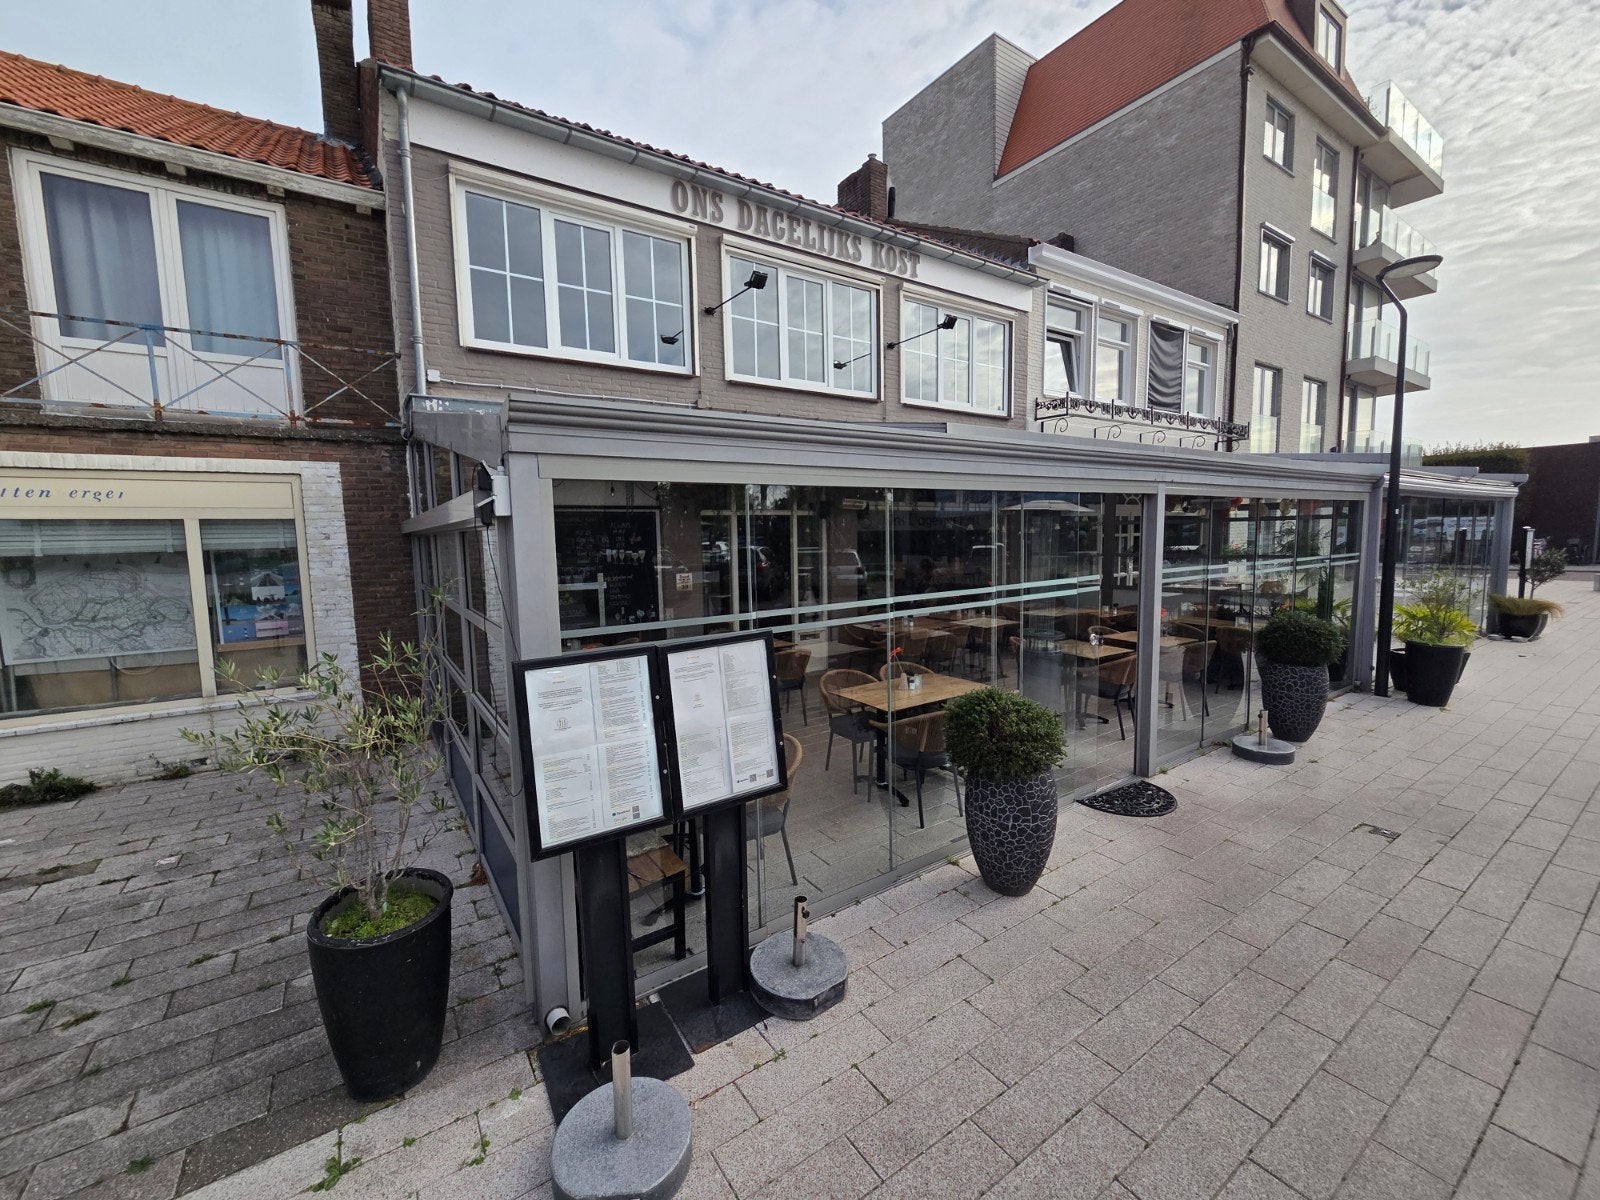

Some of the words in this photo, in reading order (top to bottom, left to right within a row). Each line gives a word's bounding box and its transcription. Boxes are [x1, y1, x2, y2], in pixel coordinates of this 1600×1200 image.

[671, 180, 724, 223] ONS
[736, 199, 862, 263] DAGELIJKS
[871, 240, 921, 278] KOST
